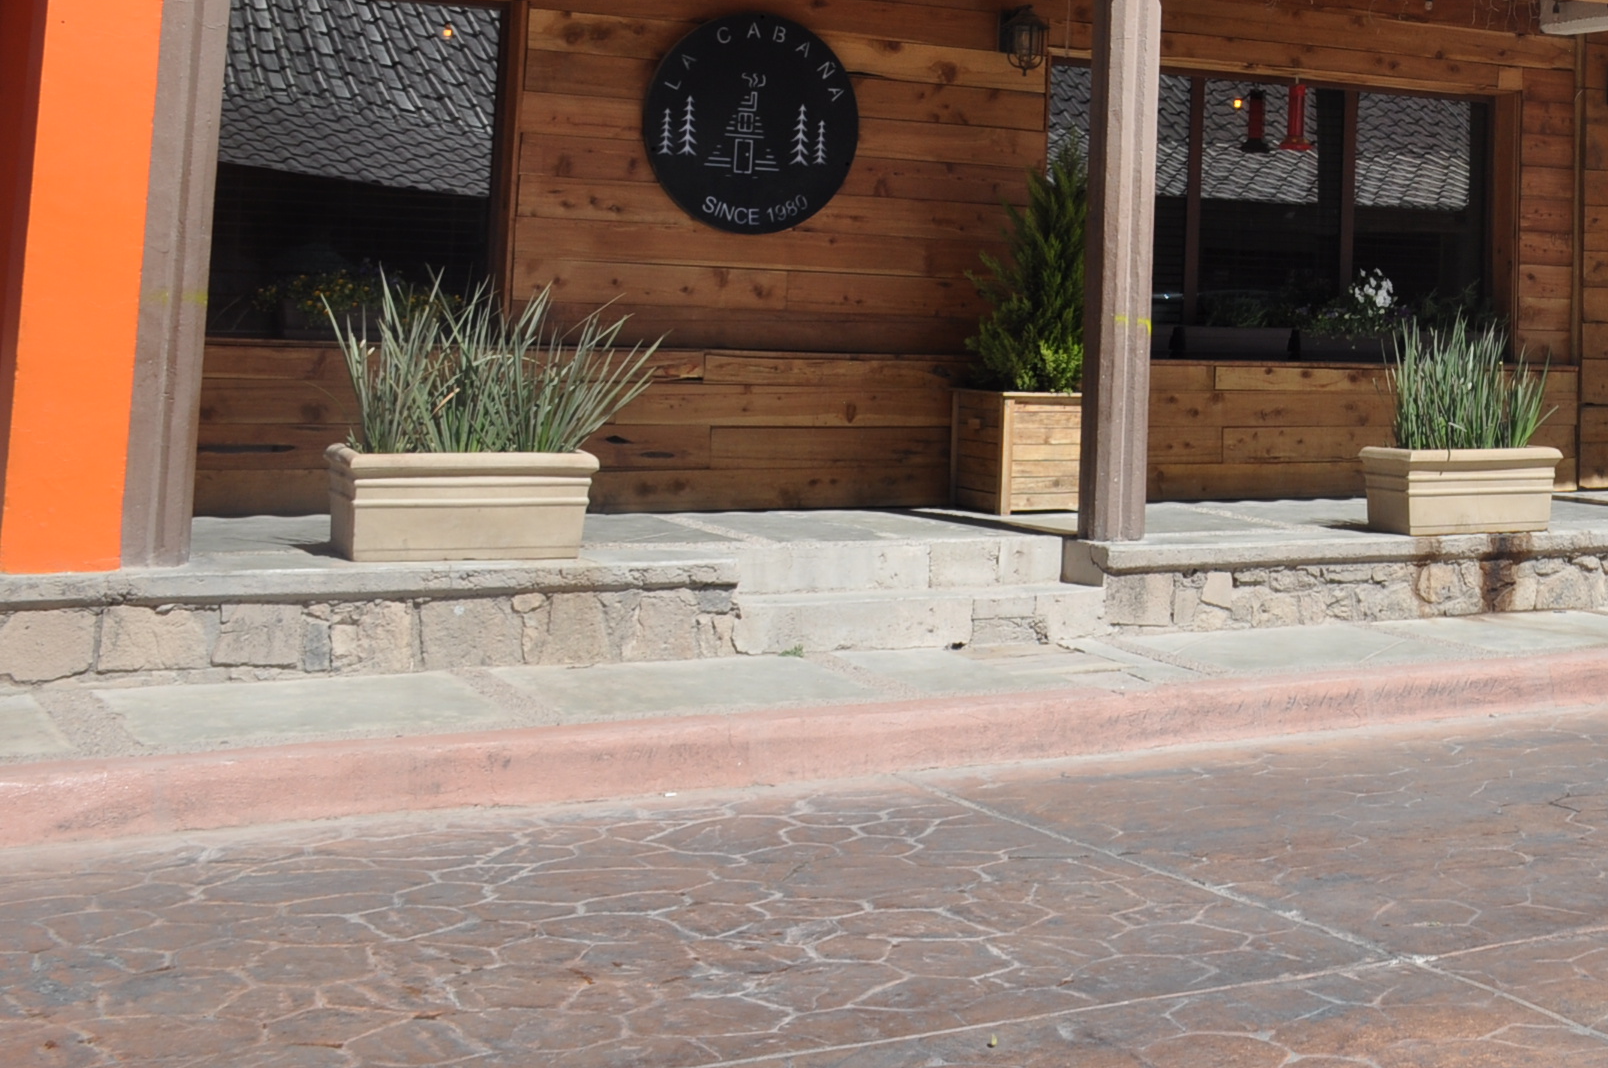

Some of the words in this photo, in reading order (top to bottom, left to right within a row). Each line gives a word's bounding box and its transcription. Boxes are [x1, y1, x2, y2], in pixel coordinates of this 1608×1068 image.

[664, 54, 697, 90] LA
[716, 21, 845, 102] CABAÑA
[702, 195, 760, 225] SINCE
[766, 194, 808, 223] 1980
